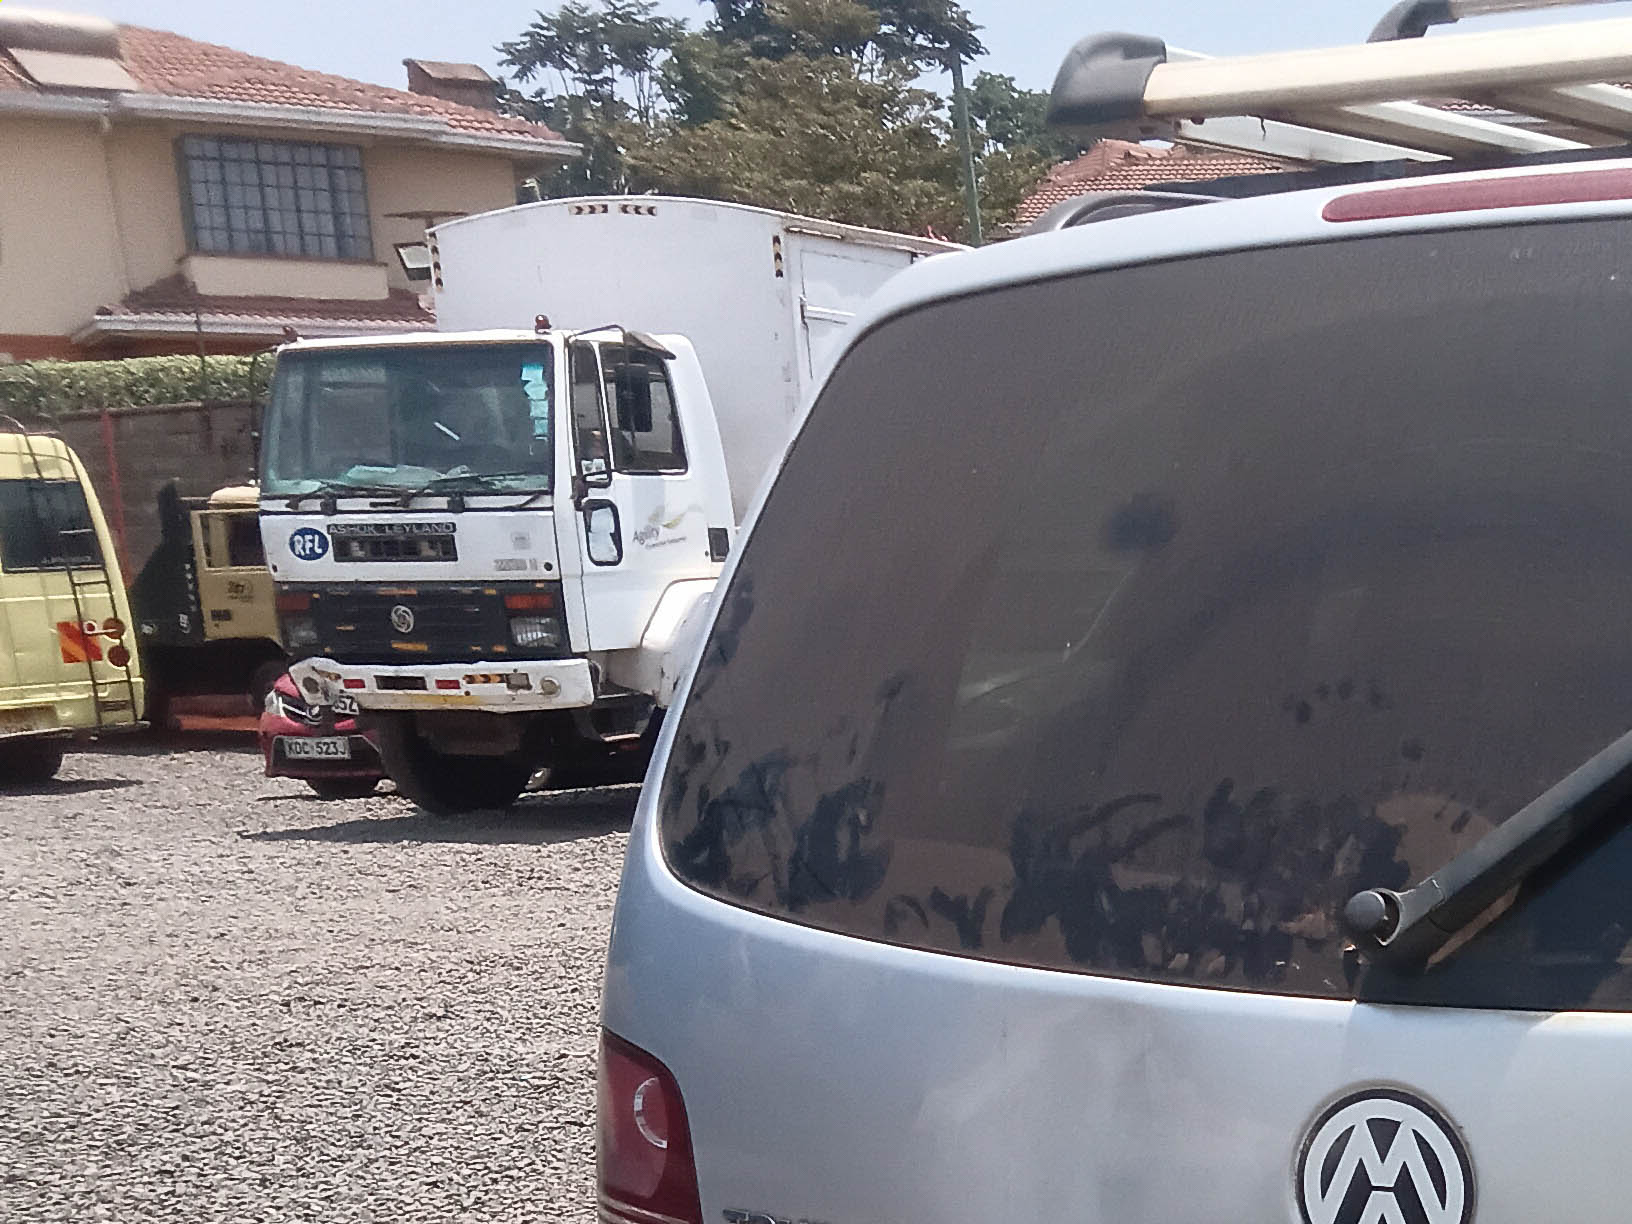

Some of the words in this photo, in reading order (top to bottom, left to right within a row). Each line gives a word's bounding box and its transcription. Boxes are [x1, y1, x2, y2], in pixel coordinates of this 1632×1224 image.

[328, 523, 377, 535] ASHOK
[385, 520, 454, 534] LEYLAND
[293, 533, 323, 557] RFL
